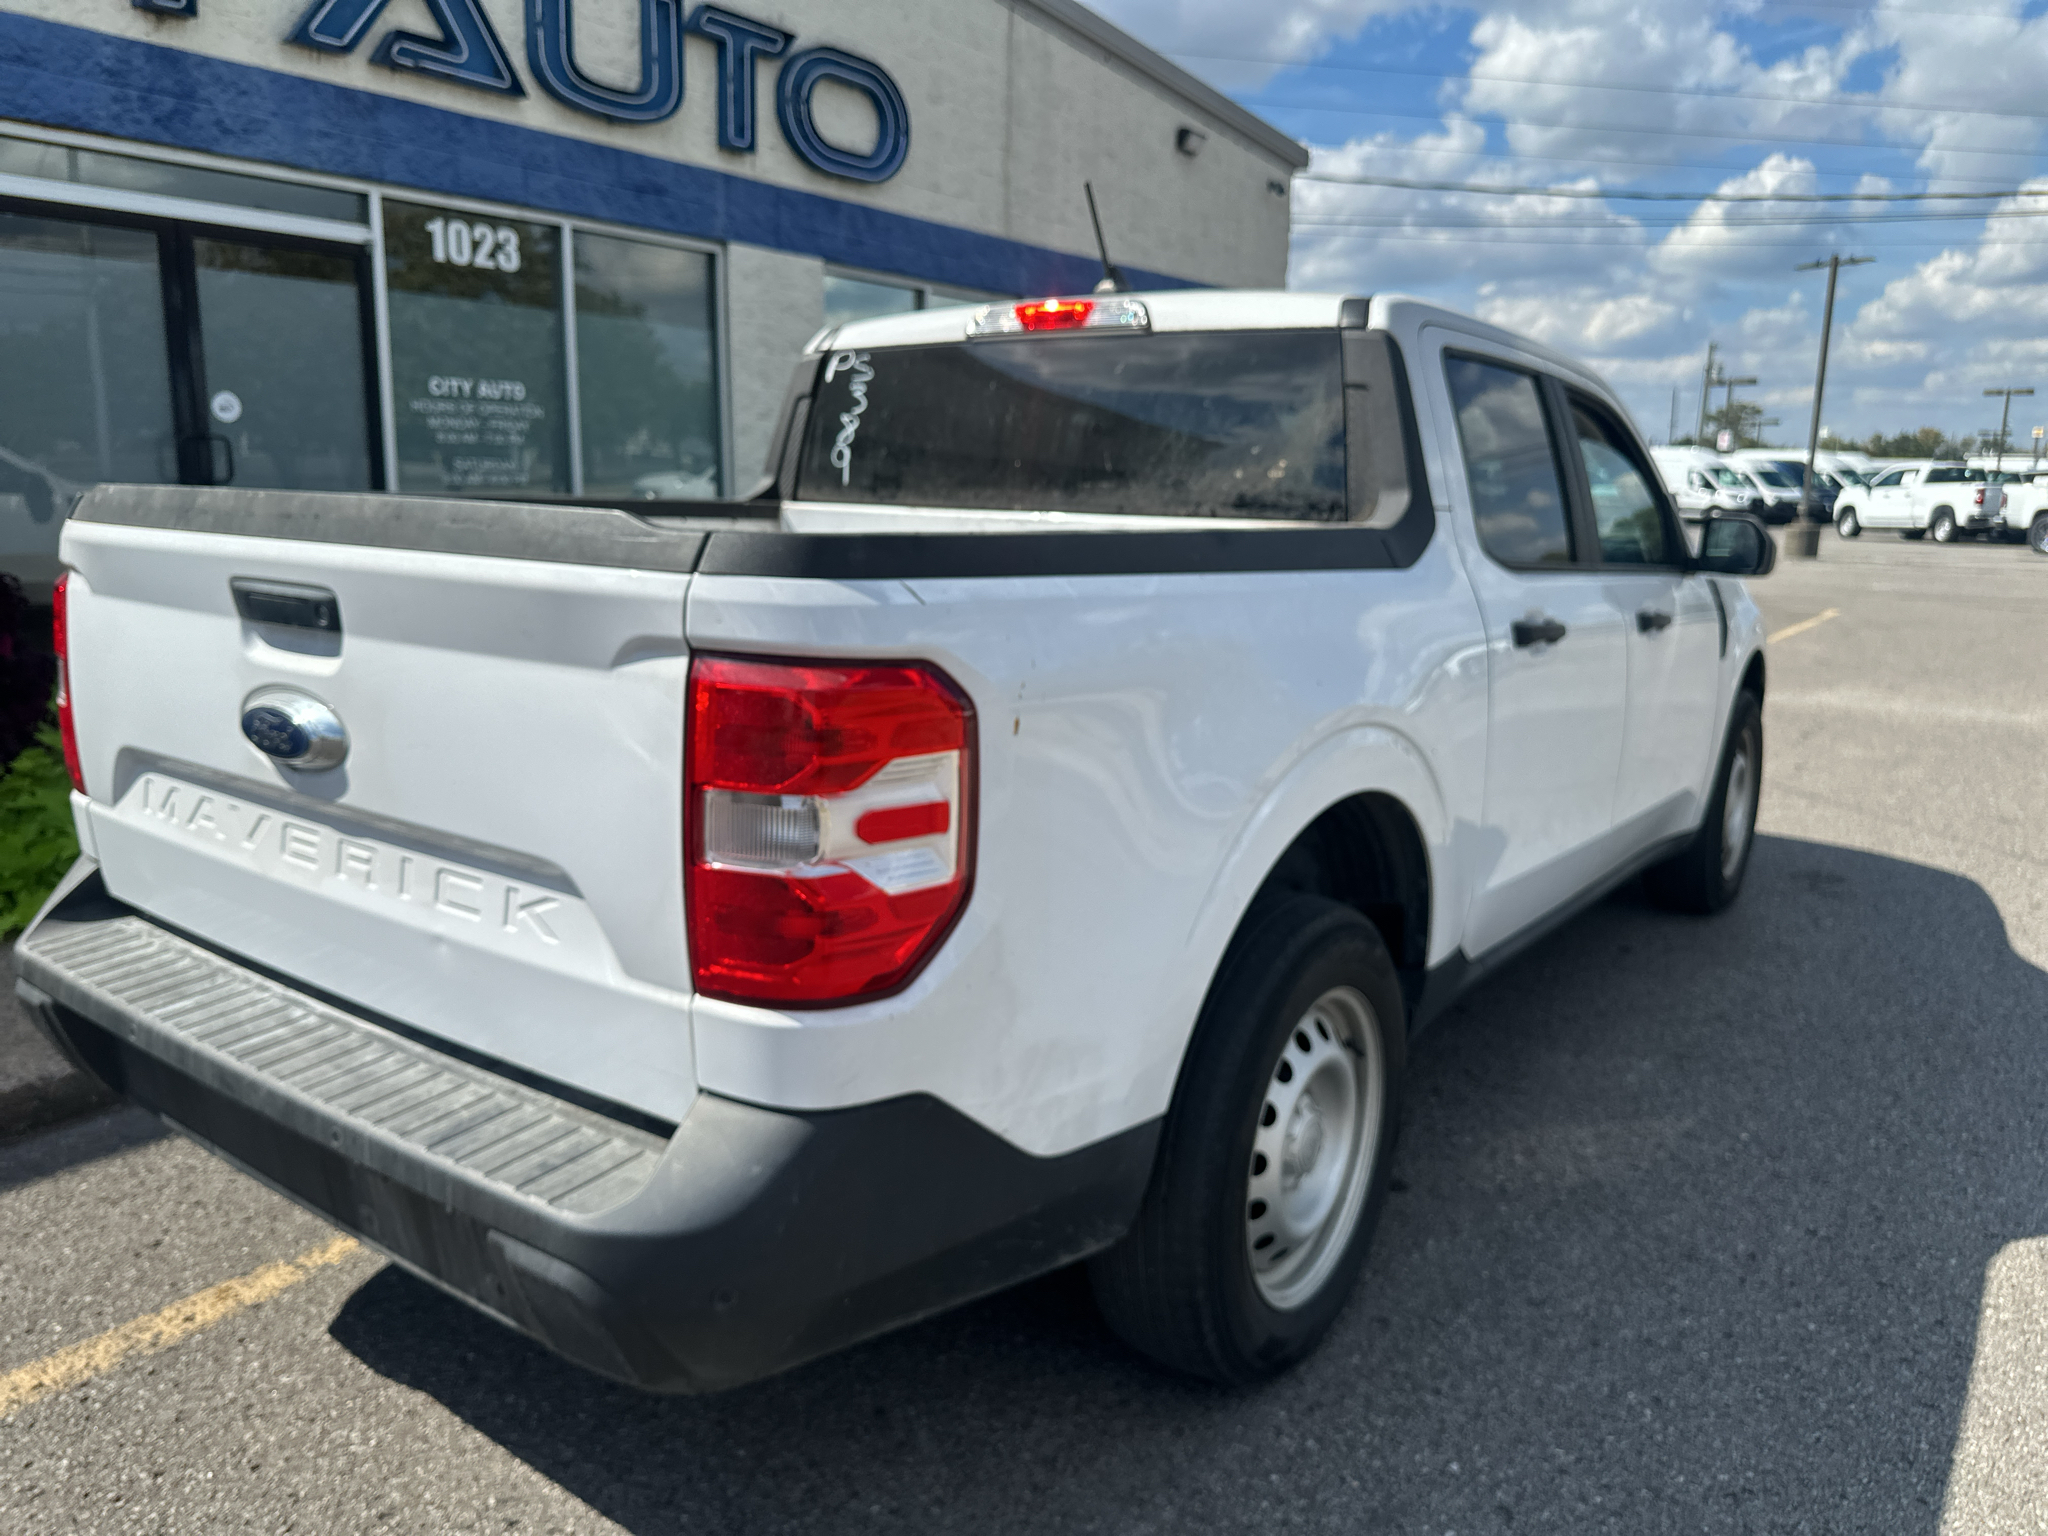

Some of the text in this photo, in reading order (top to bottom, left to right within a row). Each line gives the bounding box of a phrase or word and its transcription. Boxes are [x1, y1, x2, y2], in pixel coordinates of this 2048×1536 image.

[283, 0, 911, 184] AUTO
[424, 216, 522, 273] 1023
[427, 375, 527, 401] CITY AUTO
[142, 777, 562, 945] MAVERICK
